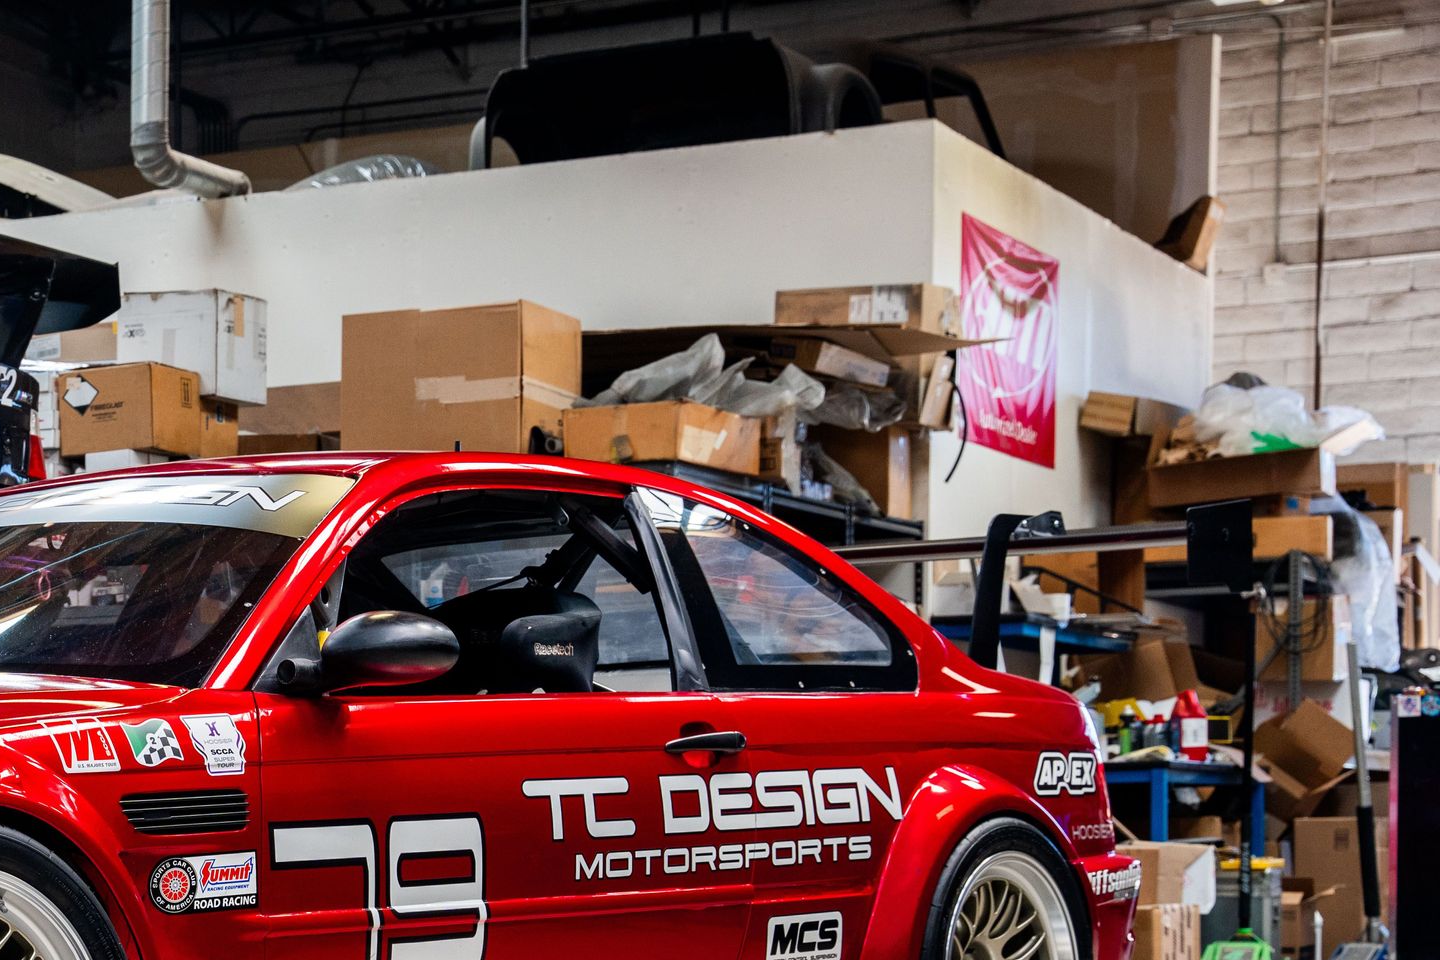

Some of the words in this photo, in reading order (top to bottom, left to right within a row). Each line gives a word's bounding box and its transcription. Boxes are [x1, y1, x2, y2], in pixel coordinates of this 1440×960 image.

[1037, 757, 1094, 787] APEX
[522, 777, 636, 841] TC
[659, 766, 903, 834] DESIGN
[575, 836, 872, 880] MOTORSPORTS
[152, 861, 171, 888] SPORTS
[172, 860, 187, 868] CAR
[186, 866, 197, 886] CLUB
[155, 896, 165, 905] OF
[165, 894, 194, 910] AMERICA
[193, 898, 221, 910] ROAD
[222, 895, 256, 908] RACING
[770, 919, 839, 956] MCS
